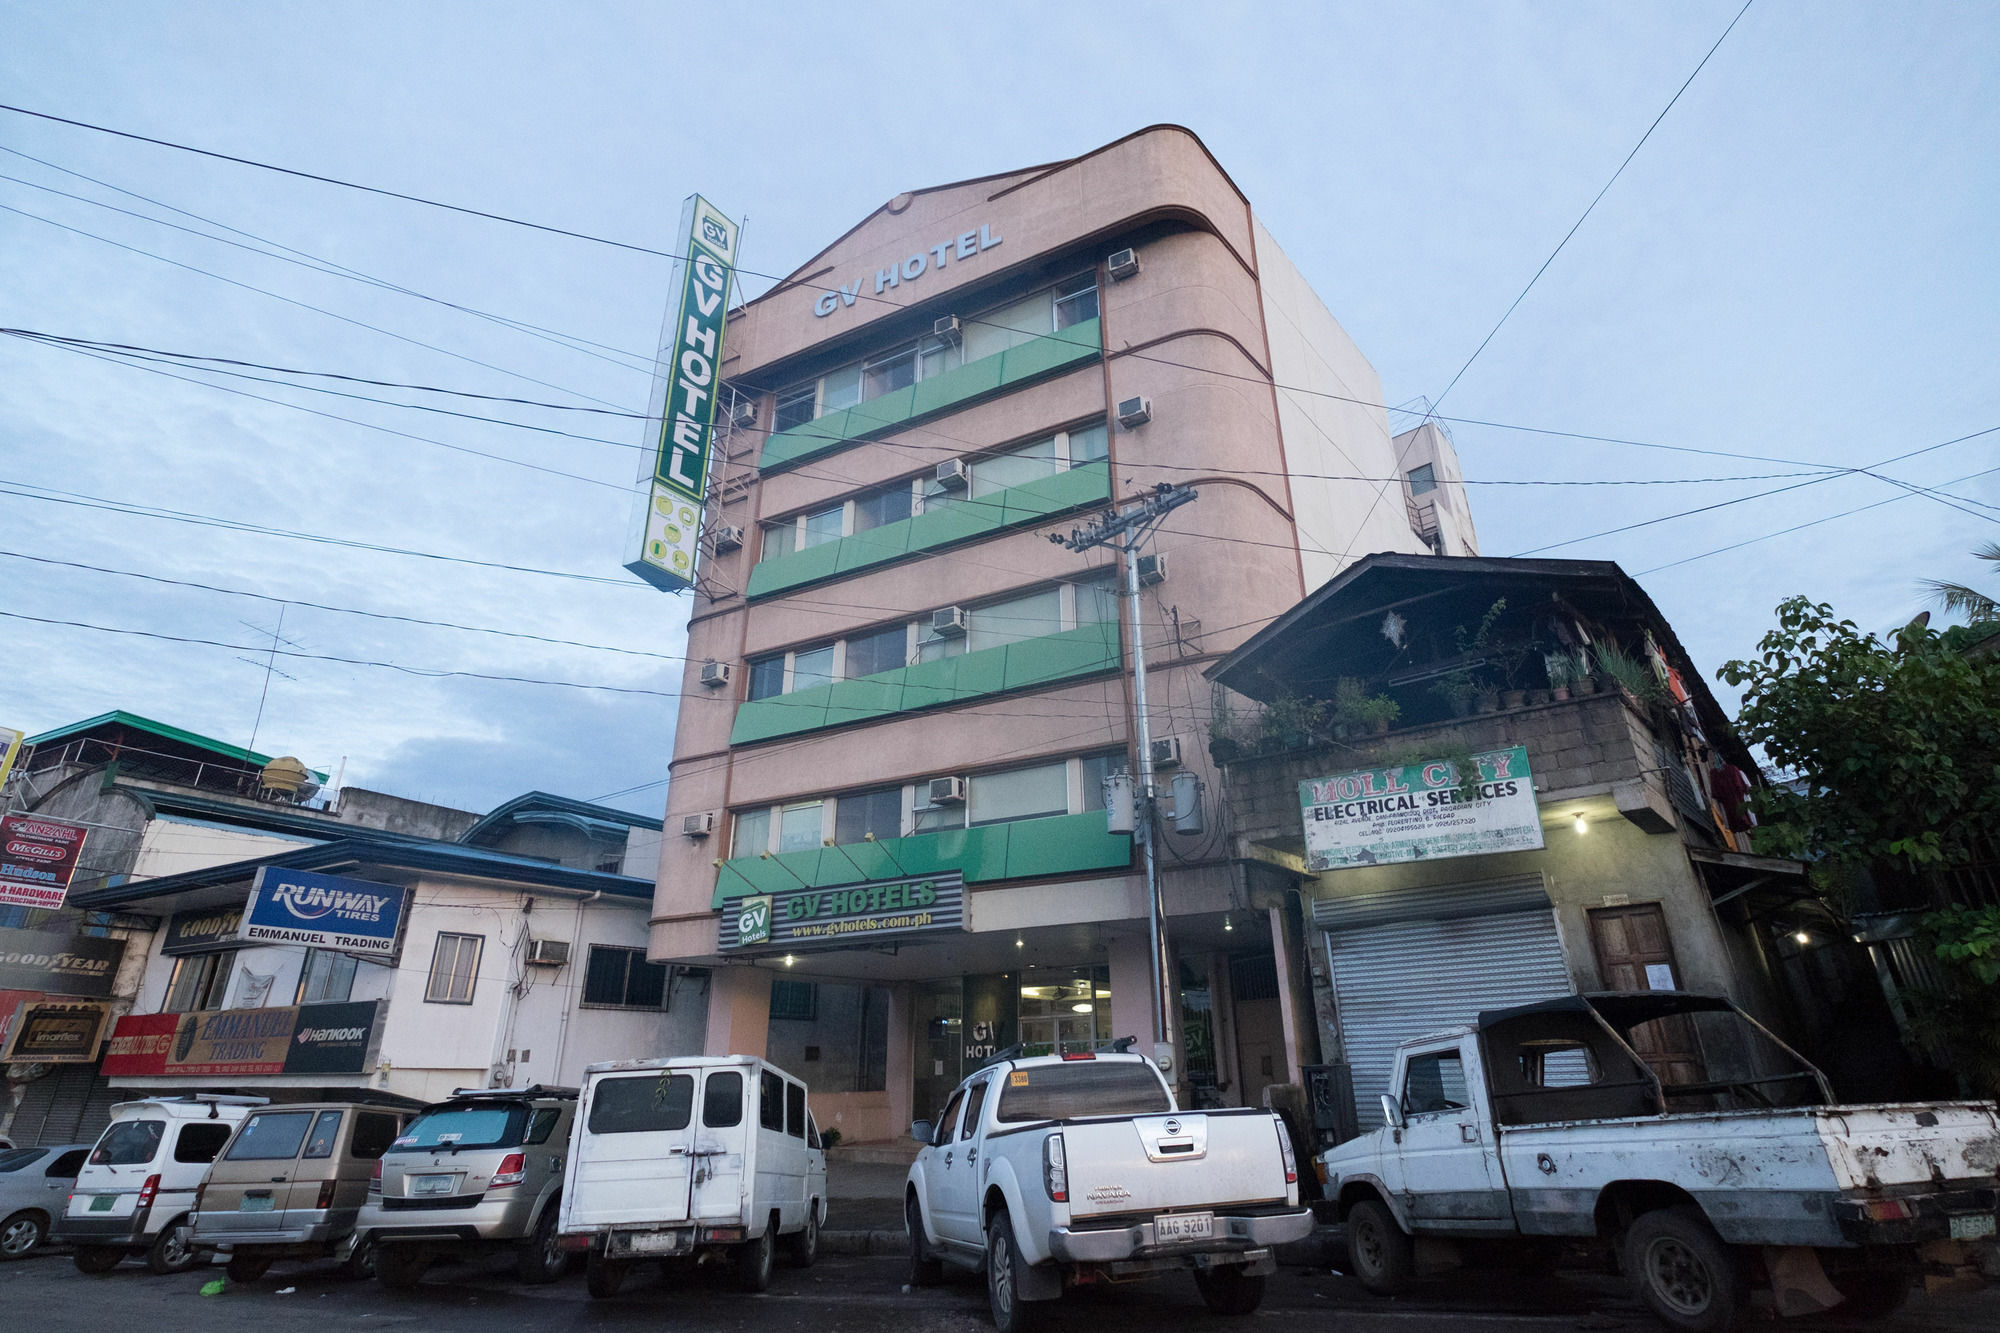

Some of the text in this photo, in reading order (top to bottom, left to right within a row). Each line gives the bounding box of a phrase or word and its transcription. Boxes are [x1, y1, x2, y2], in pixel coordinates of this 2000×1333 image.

[704, 222, 726, 242] GV
[814, 223, 1003, 318] GV HOTEL
[669, 314, 716, 489] HOTEL
[1315, 794, 1419, 822] ELECTRICAL
[1476, 800, 1491, 809] CITY
[26, 823, 77, 841] ANZAHL
[0, 863, 57, 881] Hudson
[8, 885, 64, 901] HARDWARE
[272, 883, 391, 914] RUNWAY
[787, 881, 936, 919] GV HOTELS
[335, 909, 380, 922] TIRES
[739, 907, 766, 933] GV
[792, 912, 932, 936] www.gvhotels.com.ph
[248, 927, 326, 944] EMMANUEL
[335, 936, 390, 950] TRADING
[742, 930, 766, 944] Hotels
[200, 1011, 293, 1040] EMMANUEL
[209, 1041, 265, 1060] TRADING
[1160, 1218, 1210, 1236] AAG 9201
